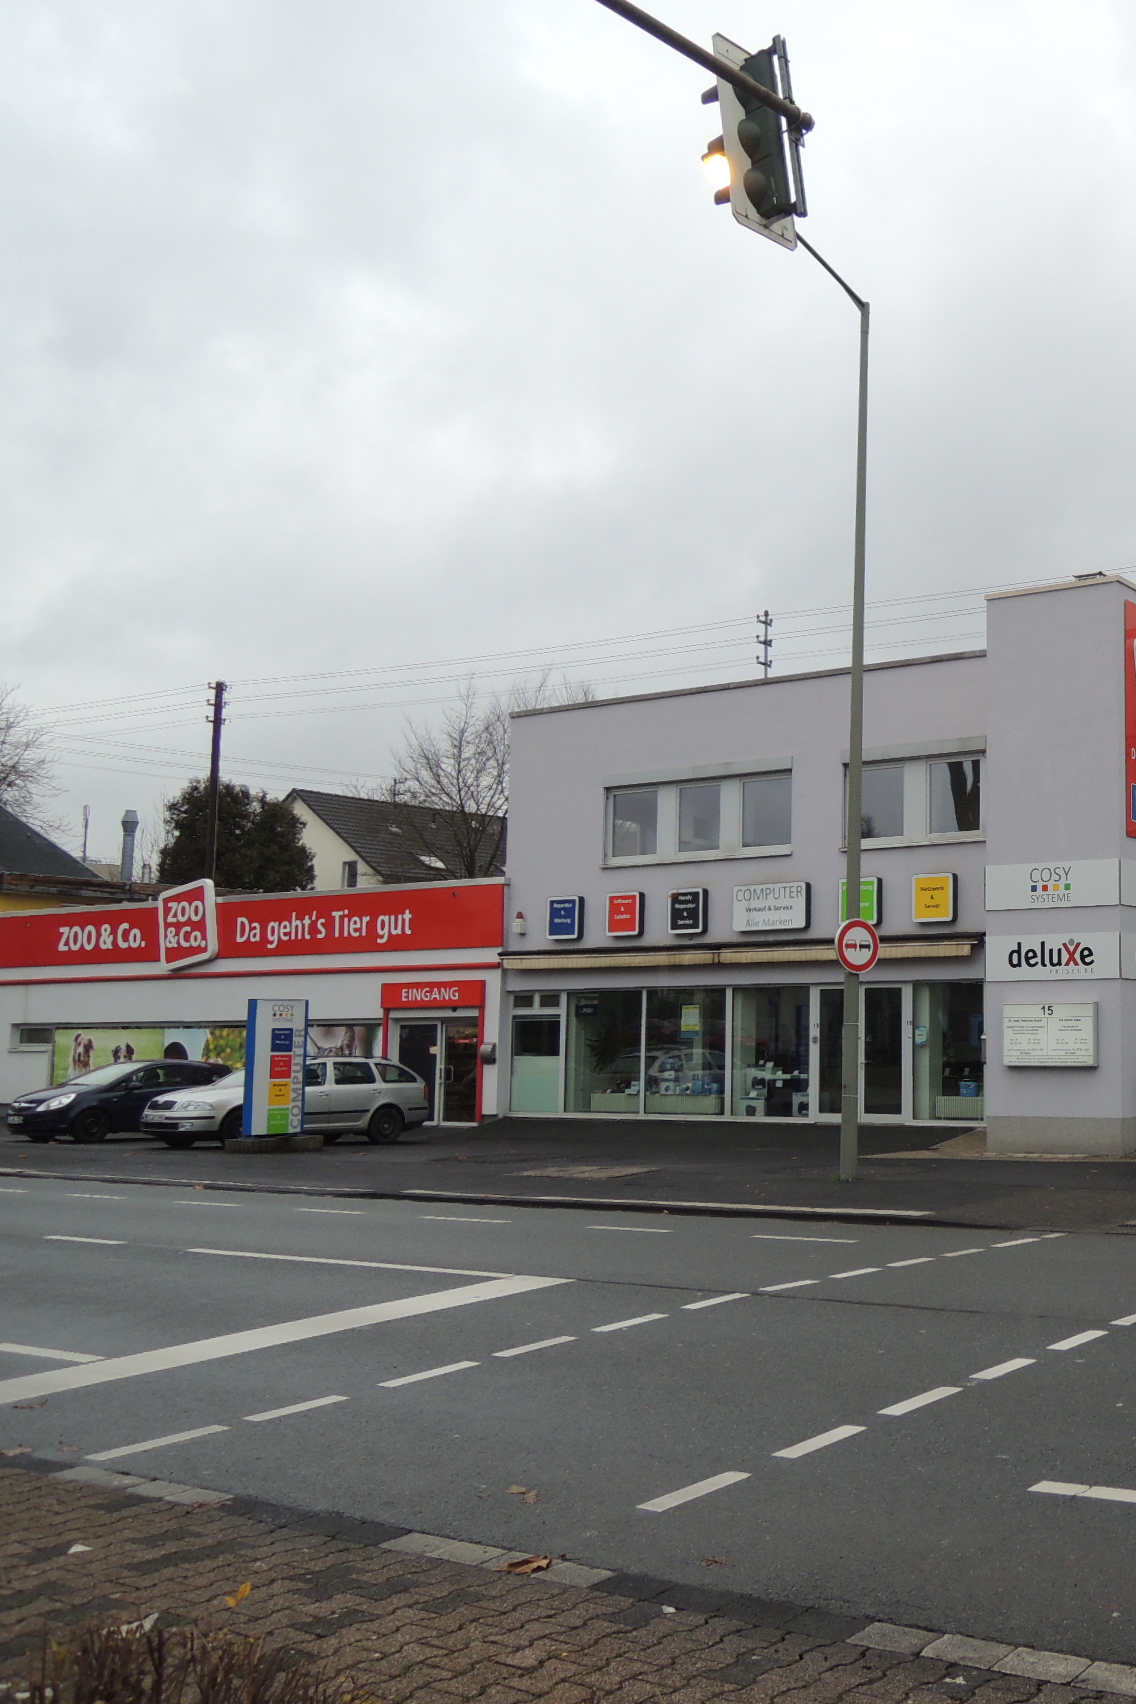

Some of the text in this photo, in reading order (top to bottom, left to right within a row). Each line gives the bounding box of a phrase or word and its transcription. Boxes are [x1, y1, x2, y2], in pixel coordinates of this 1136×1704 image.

[1030, 866, 1071, 883] COSY
[735, 885, 803, 902] COMPUTER
[1030, 893, 1071, 903] SYSTEME
[167, 900, 204, 923] ZOO
[745, 905, 766, 913] Verkauf
[773, 903, 793, 911] Service
[235, 909, 413, 949] Da geht's Tier gut
[745, 917, 793, 928] Alle Marken
[58, 923, 146, 951] ZOO & Co.
[166, 926, 206, 948] &Co.
[402, 987, 459, 1002] EINGANG
[272, 1004, 294, 1013] COSY
[1041, 1005, 1054, 1016] 15
[290, 1029, 305, 1129] COMPUTER
